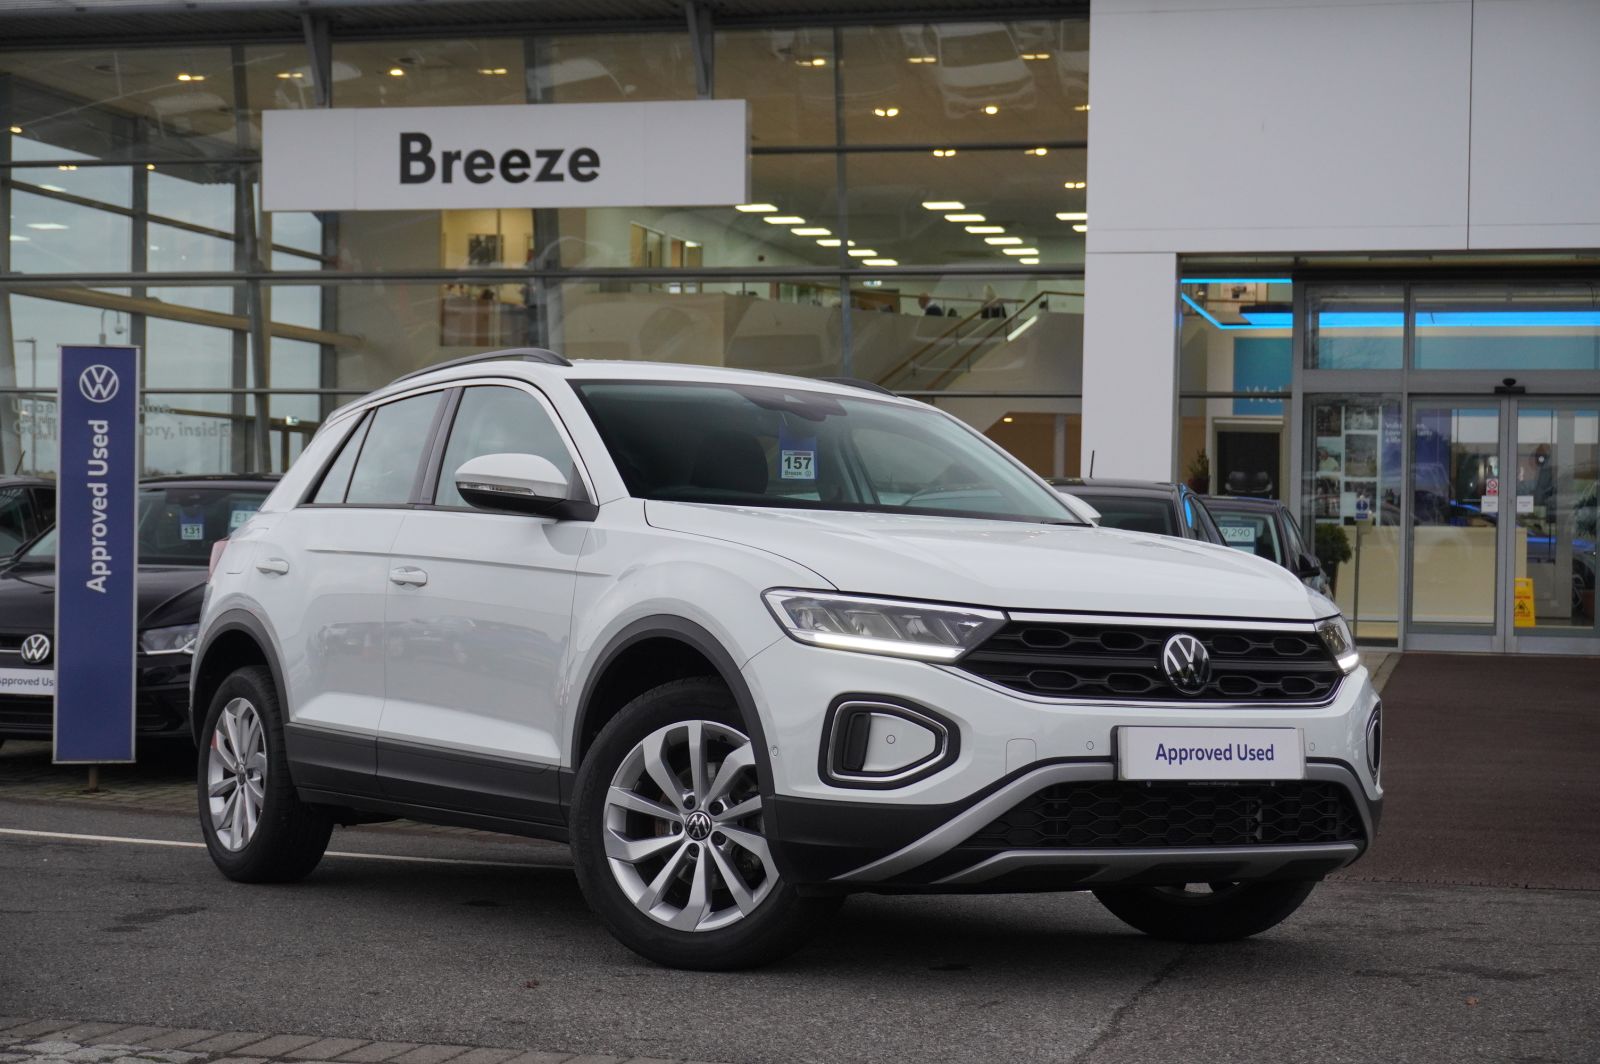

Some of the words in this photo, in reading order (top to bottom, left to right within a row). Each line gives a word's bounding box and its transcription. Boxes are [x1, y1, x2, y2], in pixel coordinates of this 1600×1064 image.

[400, 132, 601, 184] Breeze
[88, 420, 109, 476] Used
[784, 457, 812, 470] 157
[86, 483, 112, 593] Approved
[184, 526, 200, 535] 131
[1222, 528, 1250, 537] 9,290
[42, 678, 53, 686] Us
[1155, 743, 1233, 766] Approved
[1237, 744, 1275, 761] Used
